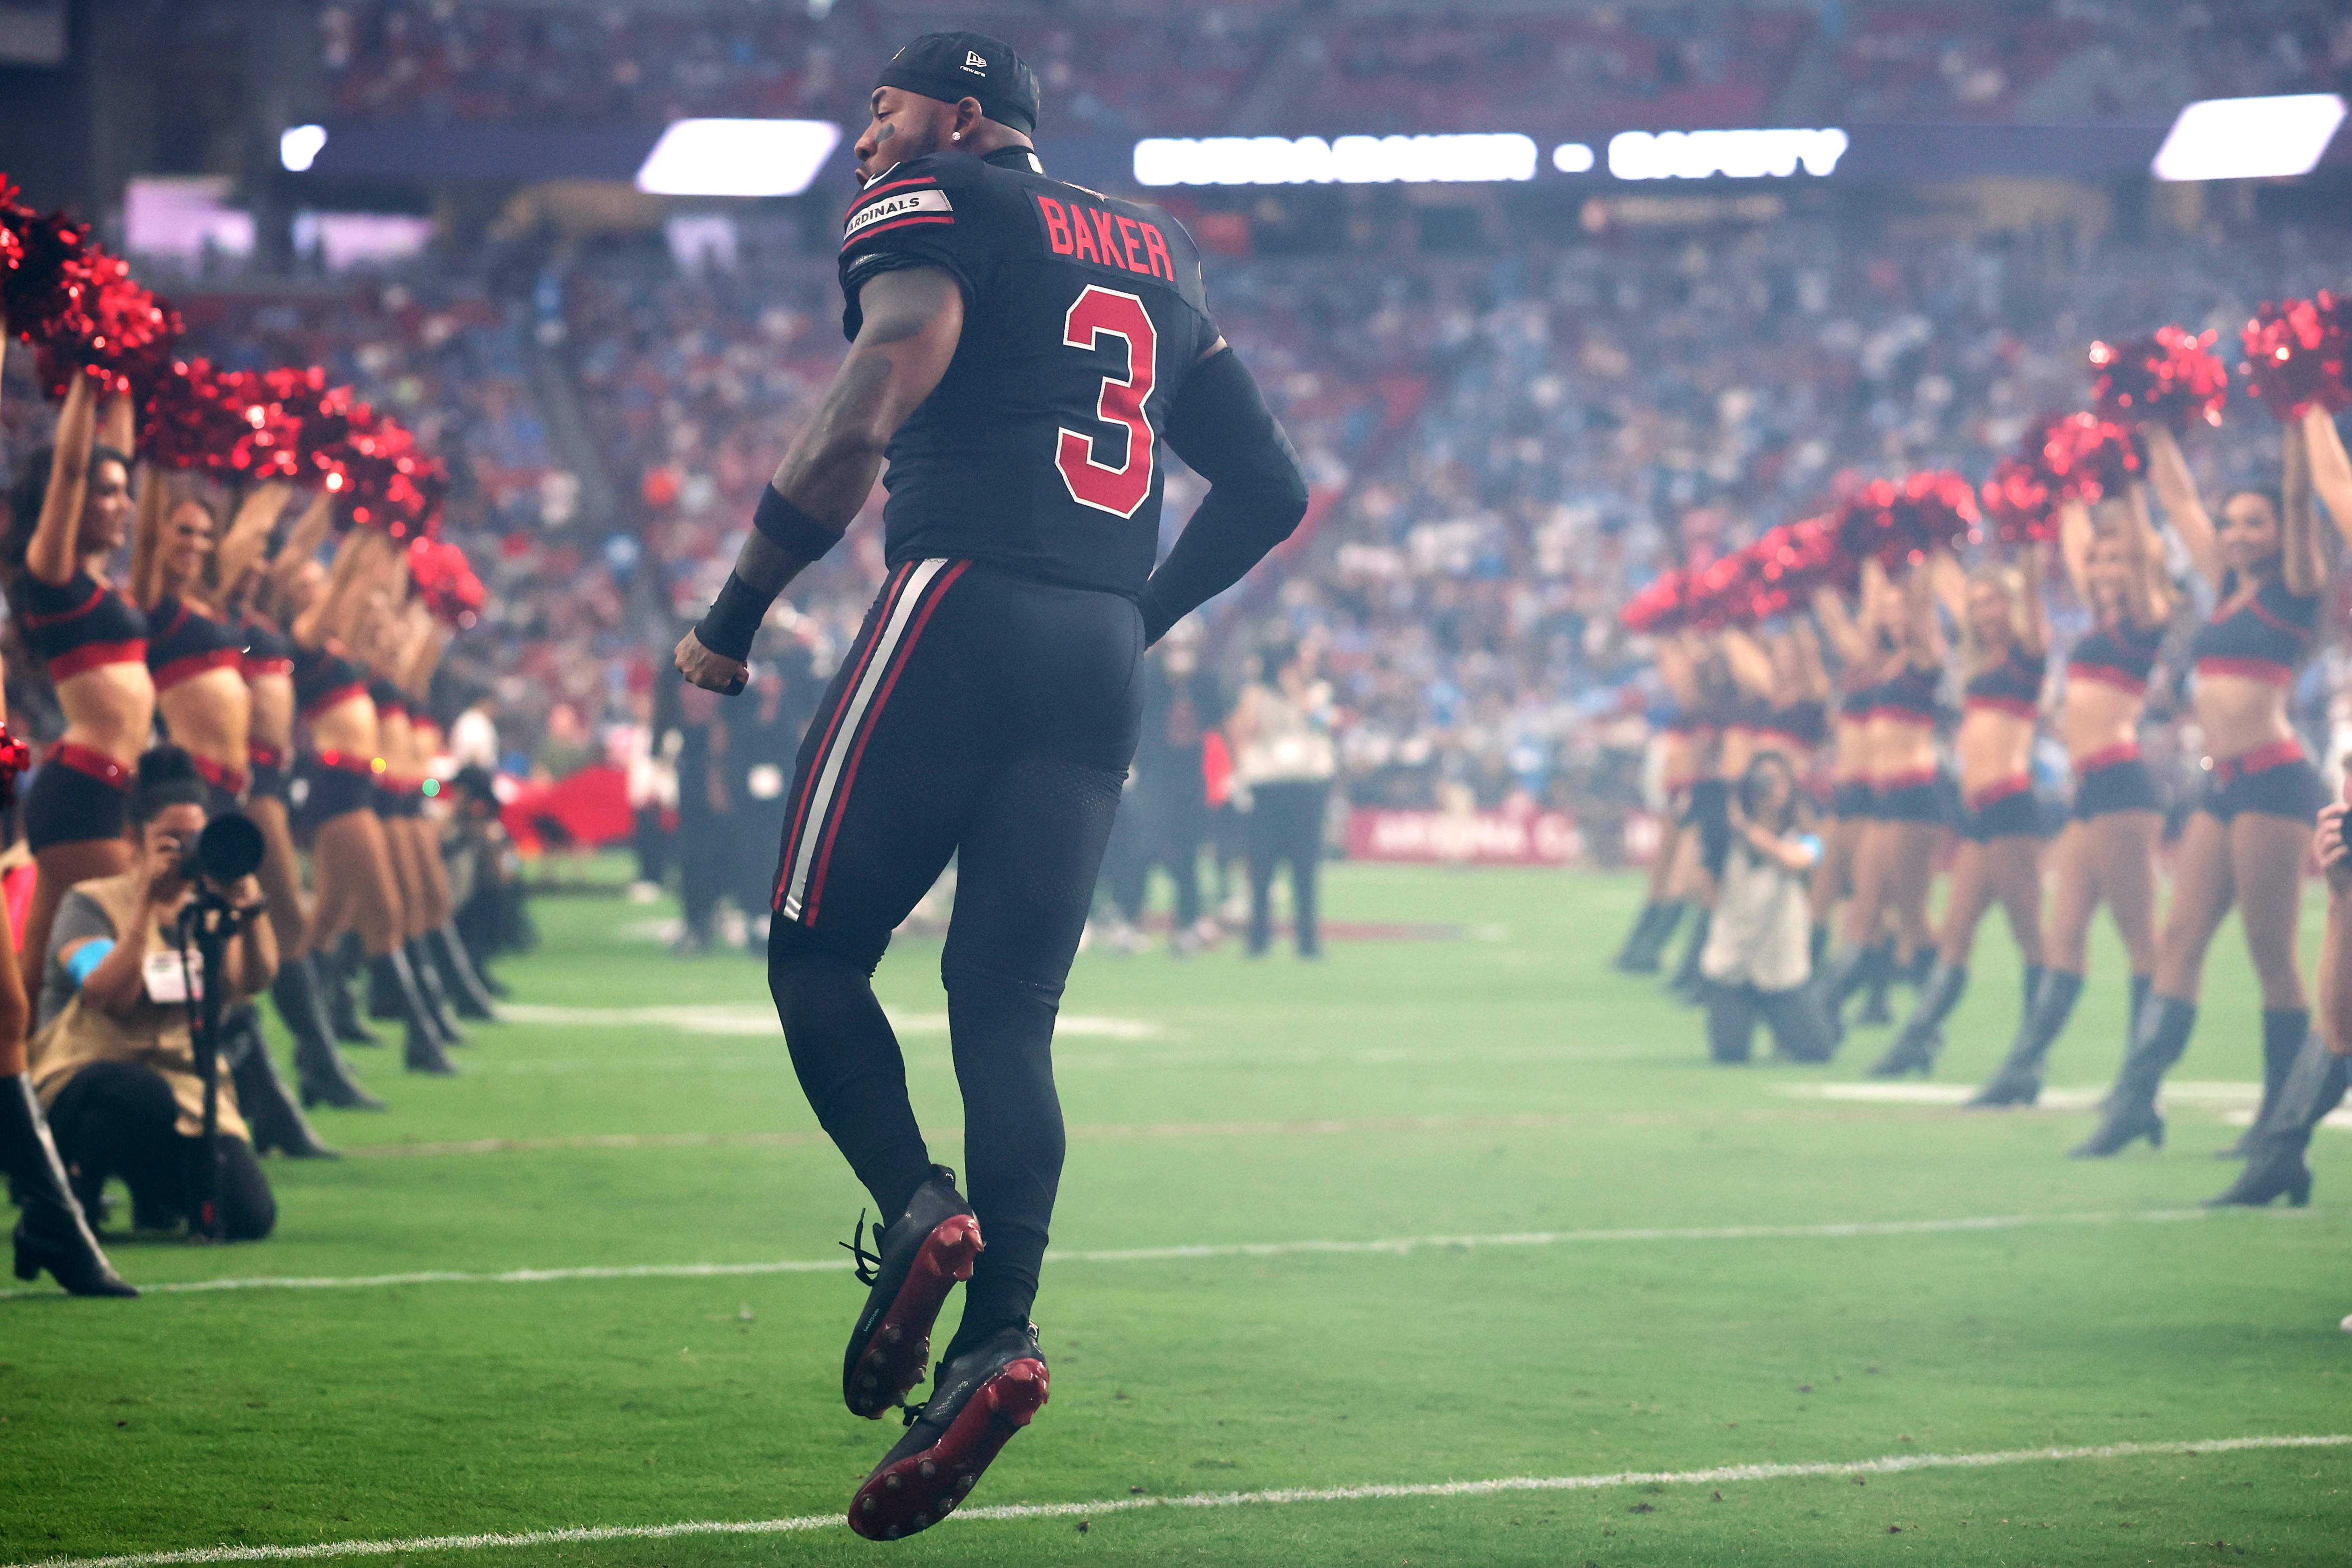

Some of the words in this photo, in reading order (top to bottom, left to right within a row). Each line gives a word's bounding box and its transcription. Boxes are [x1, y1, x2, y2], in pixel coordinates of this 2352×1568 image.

[846, 197, 920, 233] ARDINALS
[1037, 196, 1174, 281] BAKER
[1055, 284, 1157, 520] 3
